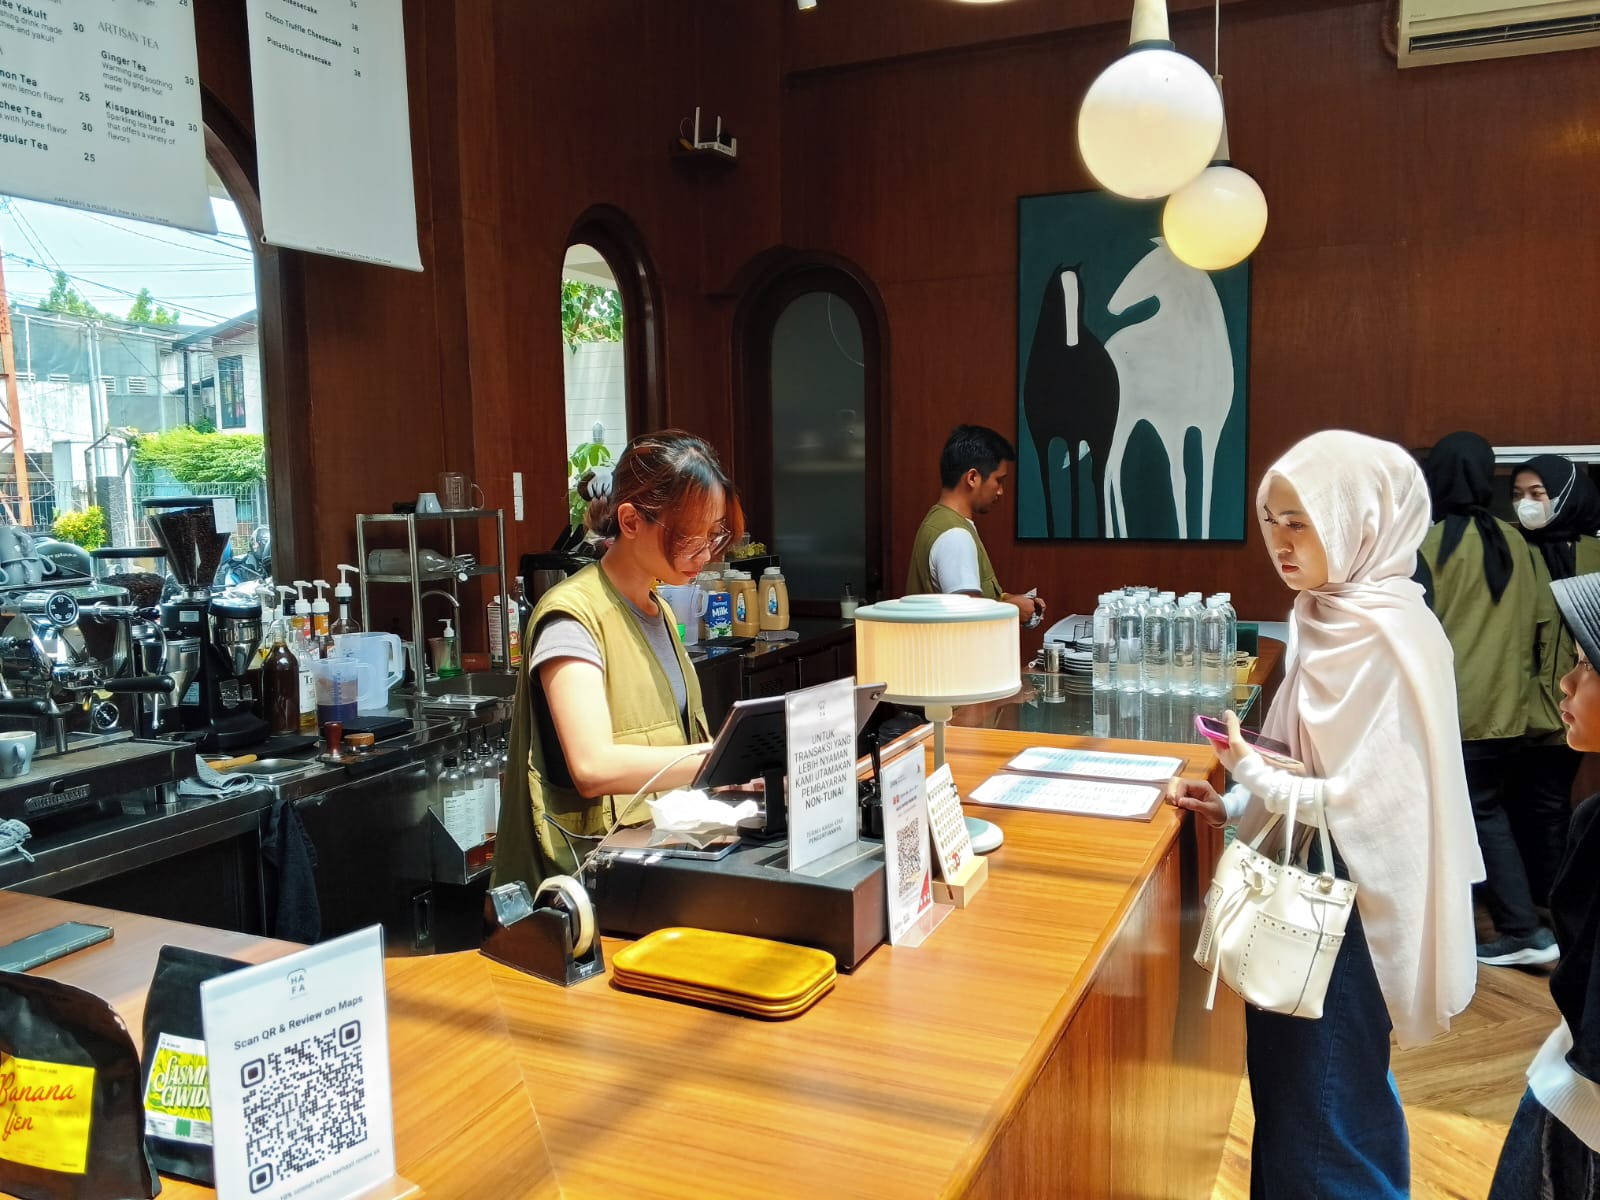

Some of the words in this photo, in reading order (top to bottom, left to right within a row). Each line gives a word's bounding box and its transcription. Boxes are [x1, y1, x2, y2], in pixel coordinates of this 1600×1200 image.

[16, 2, 48, 21] Yakult
[41, 24, 63, 36] made
[72, 21, 85, 33] 30
[265, 11, 284, 25] Choco
[285, 19, 306, 34] Truffle
[307, 28, 342, 48] Cheesecake
[98, 21, 139, 42] ARTISAN
[141, 36, 160, 51] TEA
[267, 36, 295, 54] Pistachio
[295, 48, 332, 67] Cheesecake
[101, 50, 130, 66] Ginger
[131, 59, 148, 72] Tea
[19, 73, 38, 87] Tea
[102, 62, 132, 78] Warming
[132, 71, 145, 81] and
[145, 76, 174, 91] soothing
[102, 72, 122, 84] made
[184, 75, 195, 86] 30
[1, 81, 18, 92] with
[18, 85, 42, 98] lemon
[104, 82, 123, 93] water
[79, 91, 91, 102] 25
[24, 105, 43, 120] Tea
[105, 100, 158, 125] Kissparkling
[159, 115, 176, 128] Tea
[106, 111, 137, 128] Sparkling
[21, 116, 46, 130] lychee
[81, 121, 94, 133] 30
[187, 121, 198, 133] 30
[30, 137, 49, 152] Tea
[84, 151, 97, 163] 25
[711, 606, 729, 618] Milk
[811, 729, 835, 745] UNTUK
[794, 742, 833, 764] TRANSAKSI
[834, 734, 852, 749] YANG
[798, 759, 819, 776] LEBIH
[819, 747, 849, 767] NYAMAN
[795, 772, 814, 789] KAMI
[815, 759, 851, 781] UTAMAKAN
[801, 771, 847, 799] PEMBAYARAN
[805, 785, 844, 810] NON-TUNAI
[291, 974, 305, 985] HA
[291, 984, 306, 995] FA
[234, 1035, 260, 1051] Scan
[261, 1027, 277, 1041] QR
[279, 1023, 287, 1034] &
[288, 1011, 323, 1030] Review
[324, 1006, 337, 1016] on
[338, 995, 364, 1012] Maps
[0, 1071, 76, 1107] Banana
